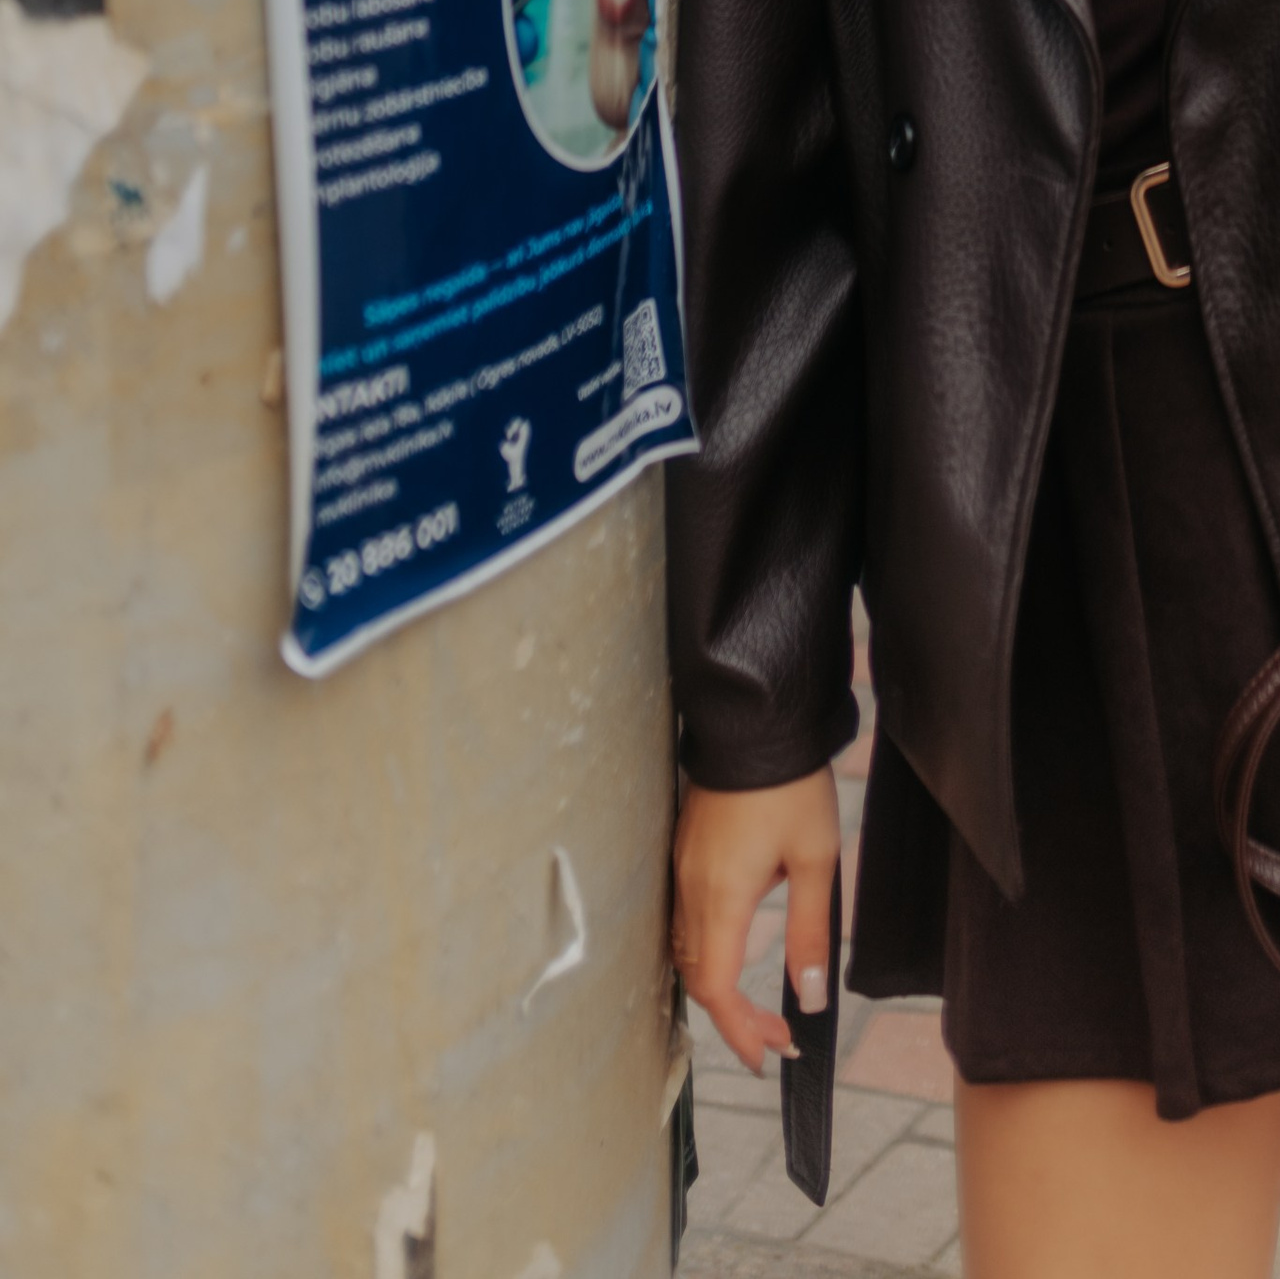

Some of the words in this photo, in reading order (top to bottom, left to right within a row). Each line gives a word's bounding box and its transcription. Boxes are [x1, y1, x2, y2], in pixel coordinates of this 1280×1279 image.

[306, 3, 348, 29] obu
[316, 365, 409, 422] NTAKTI
[327, 550, 360, 595] 20
[361, 526, 413, 576] 886
[416, 502, 460, 548] 001
